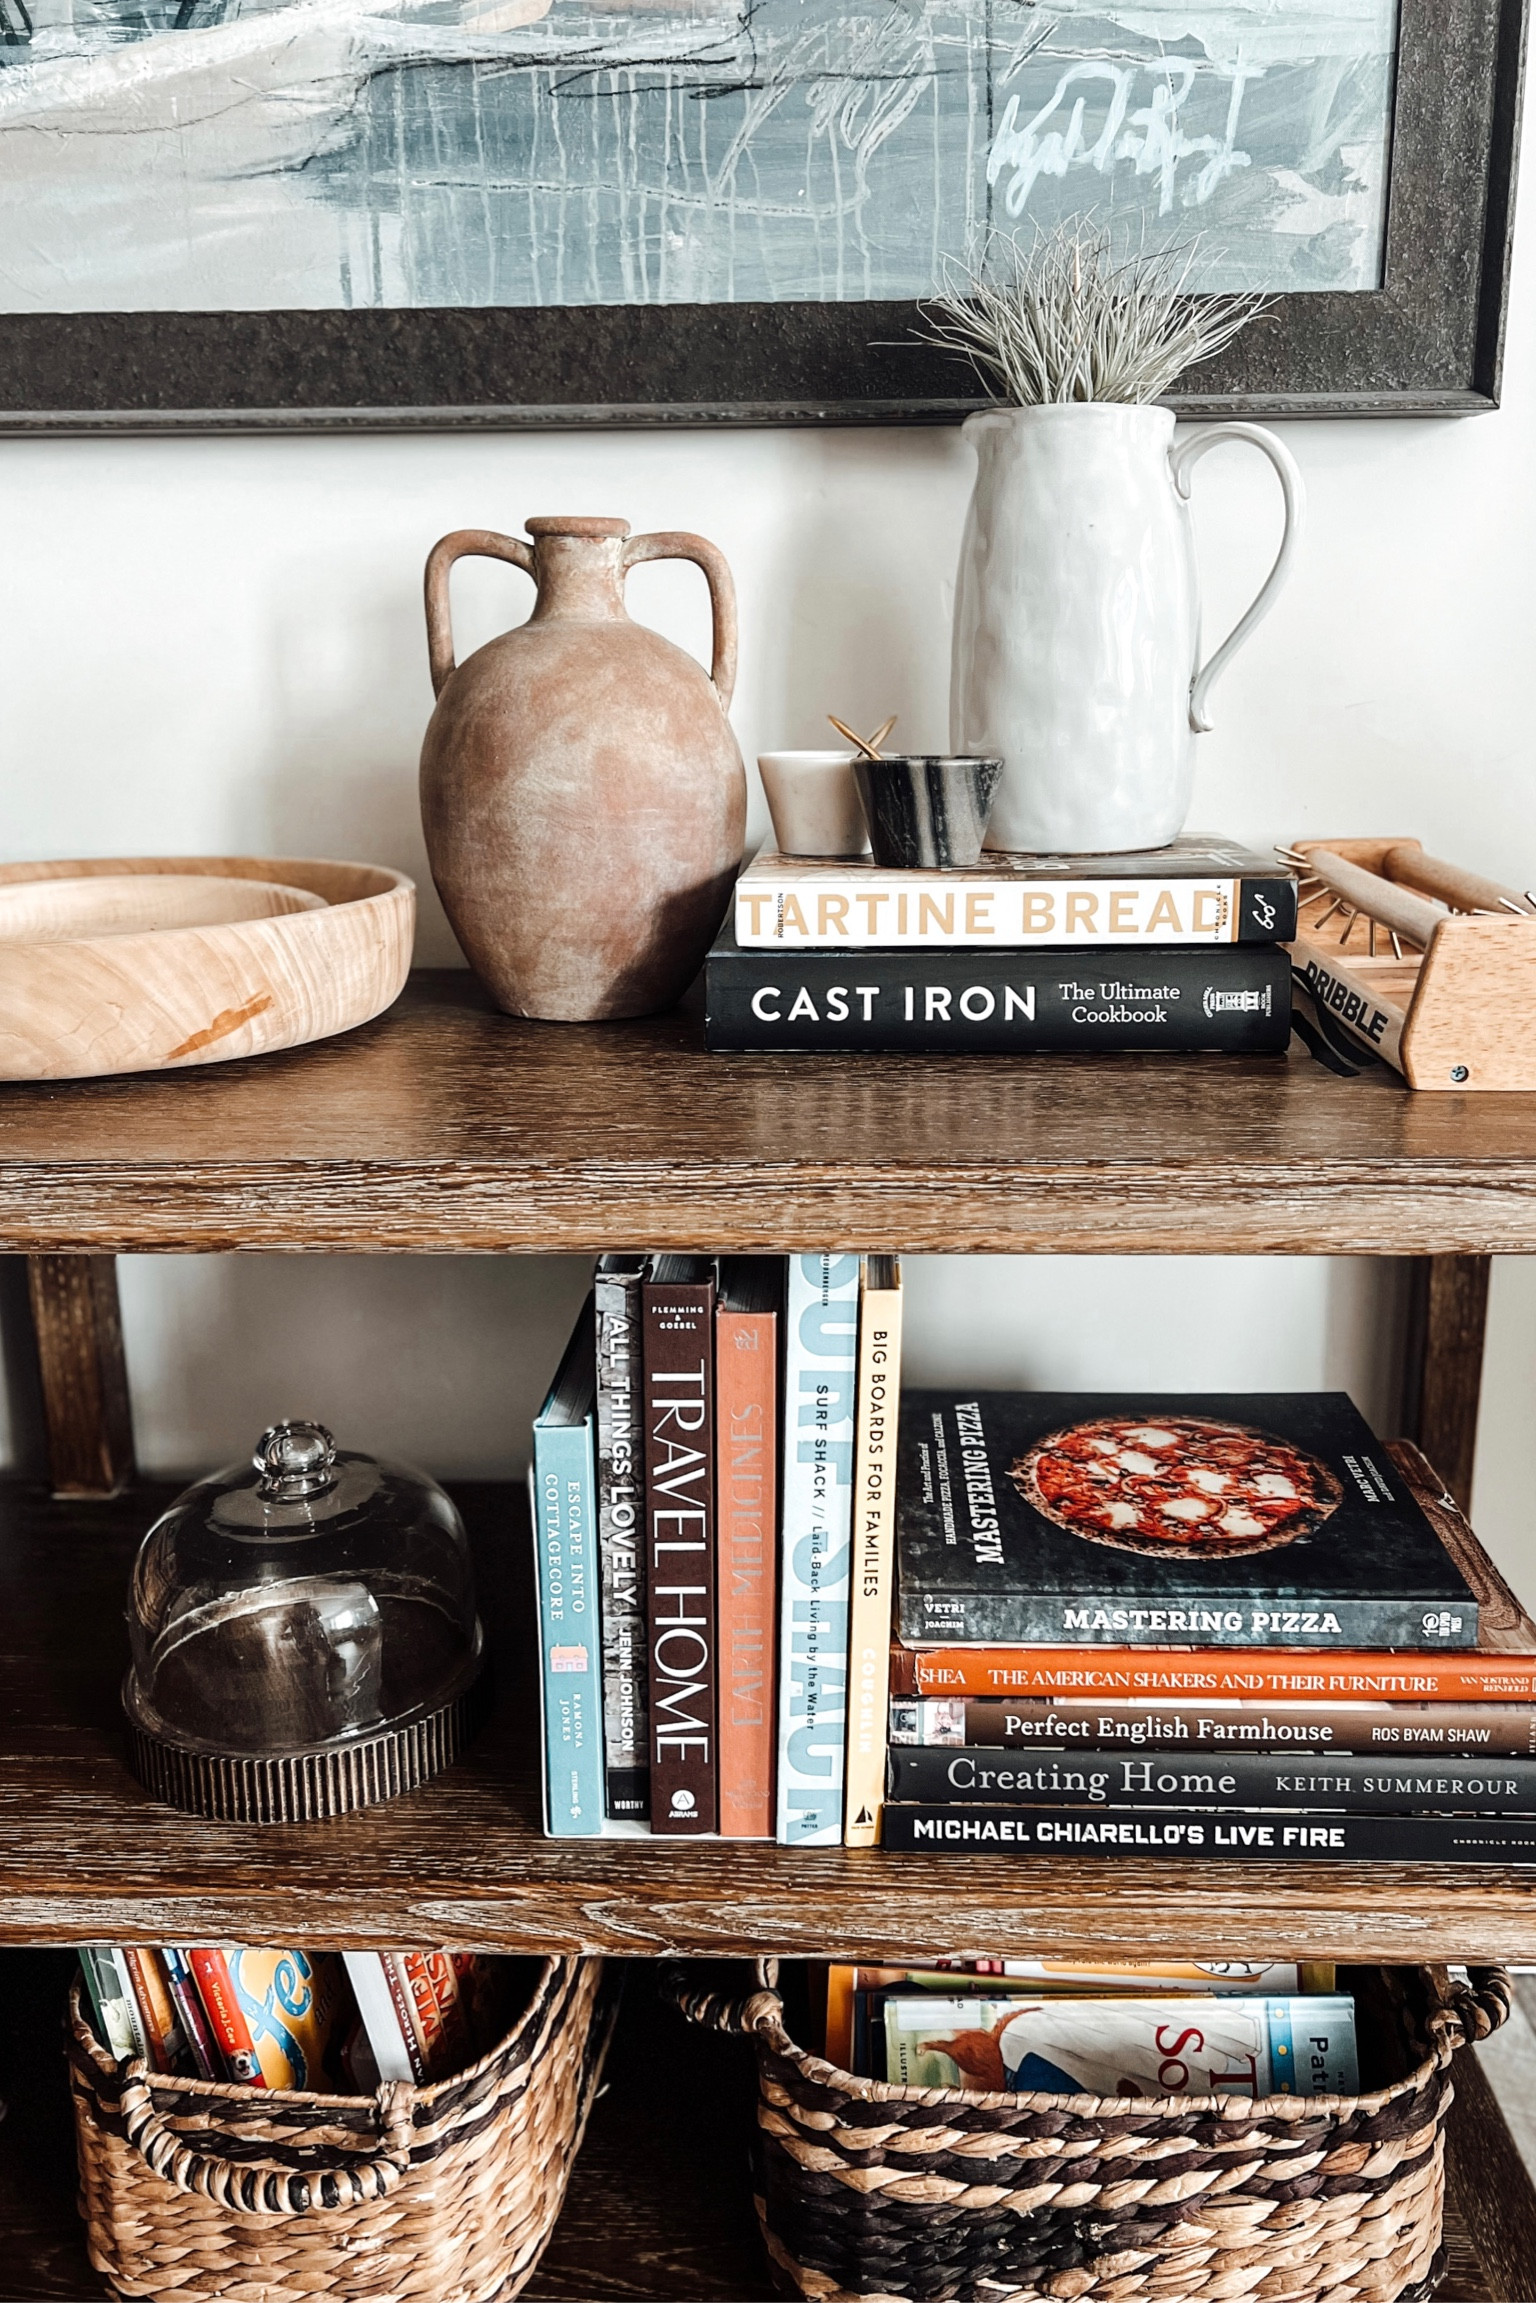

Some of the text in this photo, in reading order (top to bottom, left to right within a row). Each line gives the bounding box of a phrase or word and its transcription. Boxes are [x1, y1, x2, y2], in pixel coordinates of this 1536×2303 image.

[738, 890, 1224, 936] TARTINE BREAD
[1214, 884, 1222, 940] CHRONICLE
[751, 984, 1036, 1022] CAST IRON
[1059, 982, 1181, 1001] The Ultimate
[1305, 960, 1389, 1044] DRIBBLE
[1071, 1005, 1168, 1023] Cookbook
[652, 1306, 704, 1314] FLEMMING
[659, 1322, 697, 1330] GOEBEL
[815, 1385, 829, 1431] SURF
[932, 1412, 944, 1438] CALZONE
[609, 1317, 637, 1606] ALL THINGS LOVELY
[919, 1449, 930, 1470] Practice
[934, 1438, 945, 1448] and
[813, 1439, 827, 1499] SHACK
[863, 1331, 888, 1597] BIG BOARDS FOR FAMILIES
[920, 1470, 931, 1481] and
[954, 1402, 1004, 1564] MASTERING PIZZA
[1342, 1455, 1380, 1502] MARC VETRI
[922, 1481, 932, 1492] Art
[922, 1491, 934, 1504] The
[941, 1501, 957, 1545] HANDMADE
[545, 1473, 564, 1621] COTTAGECORE
[568, 1481, 585, 1613] ESCAPE INTO
[651, 1358, 710, 1764] TRAVEL HOME
[730, 1403, 764, 1726] EARTH MEDICINES
[807, 1600, 821, 1641] Living
[924, 1603, 965, 1614] VETRI
[925, 1620, 965, 1629] JOACHIM
[1063, 1609, 1342, 1633] MASTERING PIZZA
[806, 1646, 819, 1662] by
[618, 1628, 634, 1751] JENN JOHNSON
[807, 1667, 819, 1688] the
[918, 1668, 1439, 1692] SHEA THE AMERICAN SHAKERS AND THEIR FURNITURE
[1460, 1676, 1530, 1685] VAN NOSTRAND
[806, 1693, 818, 1730] Water
[858, 1647, 877, 1754] COUGHLIN
[559, 1700, 571, 1742] JONES
[573, 1693, 583, 1748] RAMONA
[1004, 1713, 1334, 1744] Perfect English Farmhouse
[1371, 1727, 1491, 1744] ROS BYAM SHAW
[571, 1770, 579, 1804] STERLING
[947, 1756, 1237, 1801] Creating Home
[1275, 1776, 1519, 1795] KEITH SUMMEROUR
[614, 1800, 644, 1810] WORTHY
[668, 1810, 699, 1818] ABRAMS
[913, 1819, 1346, 1847] MICHAEL CHIARELLO'S LIVE FIRE
[1453, 1838, 1507, 1846] CHRONICLE
[127, 1950, 156, 2033] Pilgrim Adventures
[211, 1981, 228, 2020] Victoria
[224, 2026, 236, 2045] Coe
[899, 2042, 908, 2084] ILLUSTR
[1155, 2024, 1205, 2098] So
[1208, 2053, 1259, 2098] T
[1309, 2037, 1330, 2097] Patr
